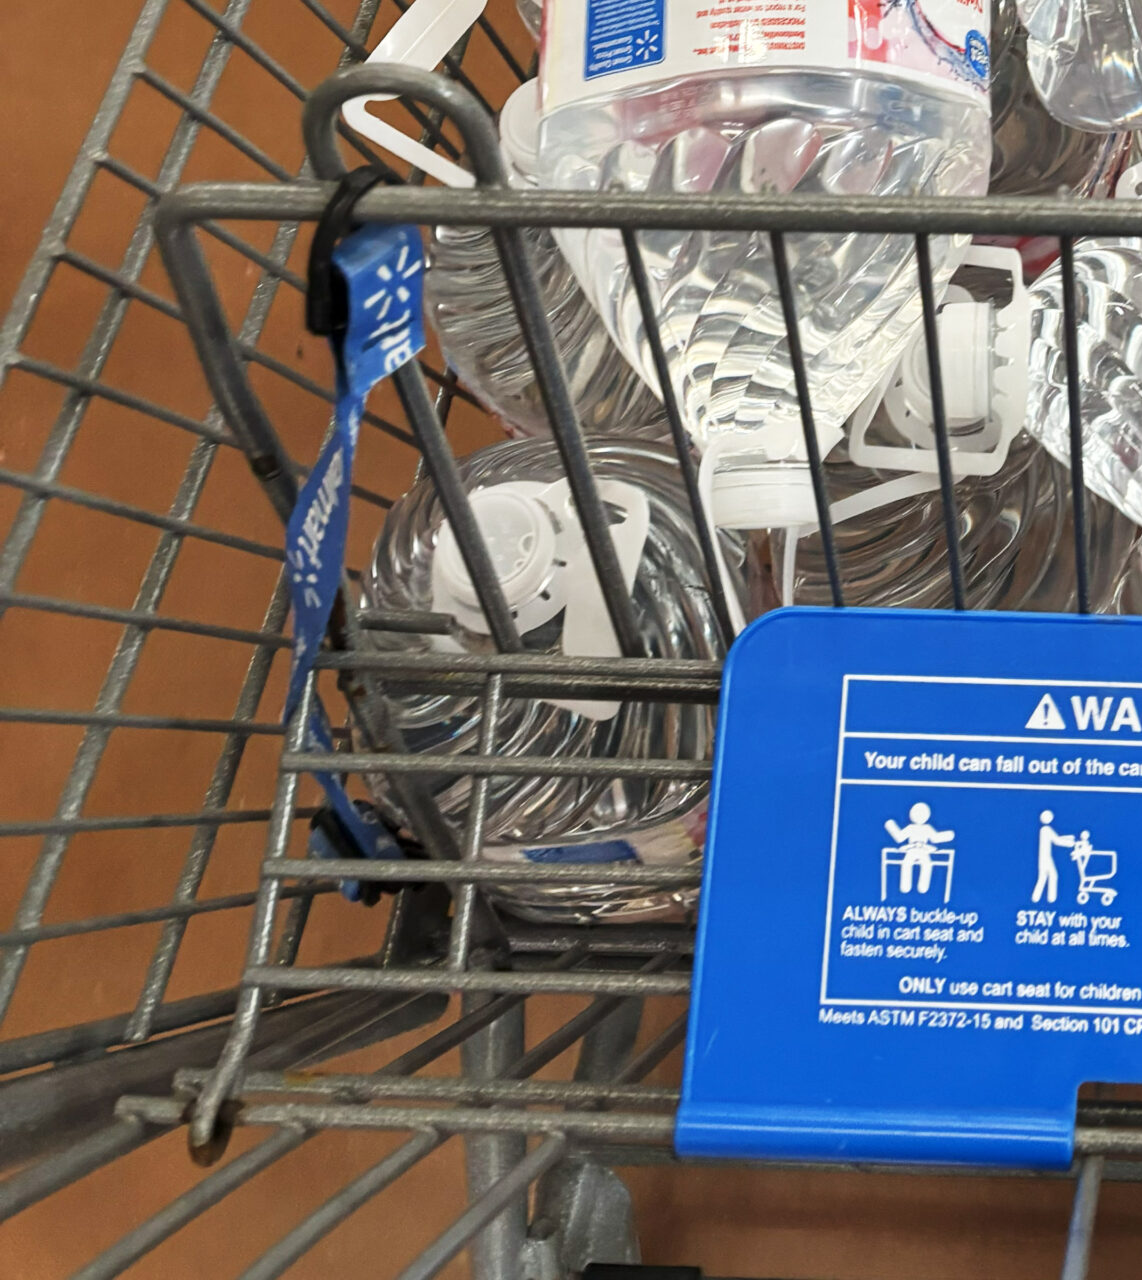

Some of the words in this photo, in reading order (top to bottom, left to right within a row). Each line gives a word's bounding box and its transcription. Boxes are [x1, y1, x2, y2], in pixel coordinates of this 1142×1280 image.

[865, 751, 905, 770] Your
[910, 753, 955, 771] child
[959, 757, 991, 773] can
[996, 756, 1024, 773] fall
[1028, 757, 1058, 774] out
[1063, 757, 1081, 774] of
[1086, 758, 1114, 775] the
[842, 906, 907, 923] ALWAYS
[910, 908, 978, 926] buckle-up
[1016, 911, 1056, 926] STAY
[1059, 912, 1087, 928] with
[1091, 916, 1122, 934] your
[842, 924, 874, 939] child
[878, 924, 890, 939] in
[894, 926, 920, 941] cart
[924, 926, 953, 941] seat
[957, 928, 983, 942] and
[1015, 930, 1048, 945] child
[1052, 932, 1065, 945] at
[1069, 931, 1085, 946] all
[1089, 931, 1130, 948] times.
[840, 941, 883, 957] fasten
[886, 943, 948, 963] securely.
[899, 976, 946, 994] ONLY
[949, 981, 979, 995] use
[982, 981, 1012, 997] cart
[1016, 981, 1050, 998] seat
[1054, 981, 1076, 998] for
[1079, 982, 1142, 1001] children
[819, 1009, 865, 1025] Meets
[868, 1010, 914, 1026] ASTM
[918, 1011, 991, 1029] F2372-15
[994, 1014, 1023, 1030] and
[1031, 1015, 1088, 1033] Section
[1093, 1017, 1119, 1034] 101
